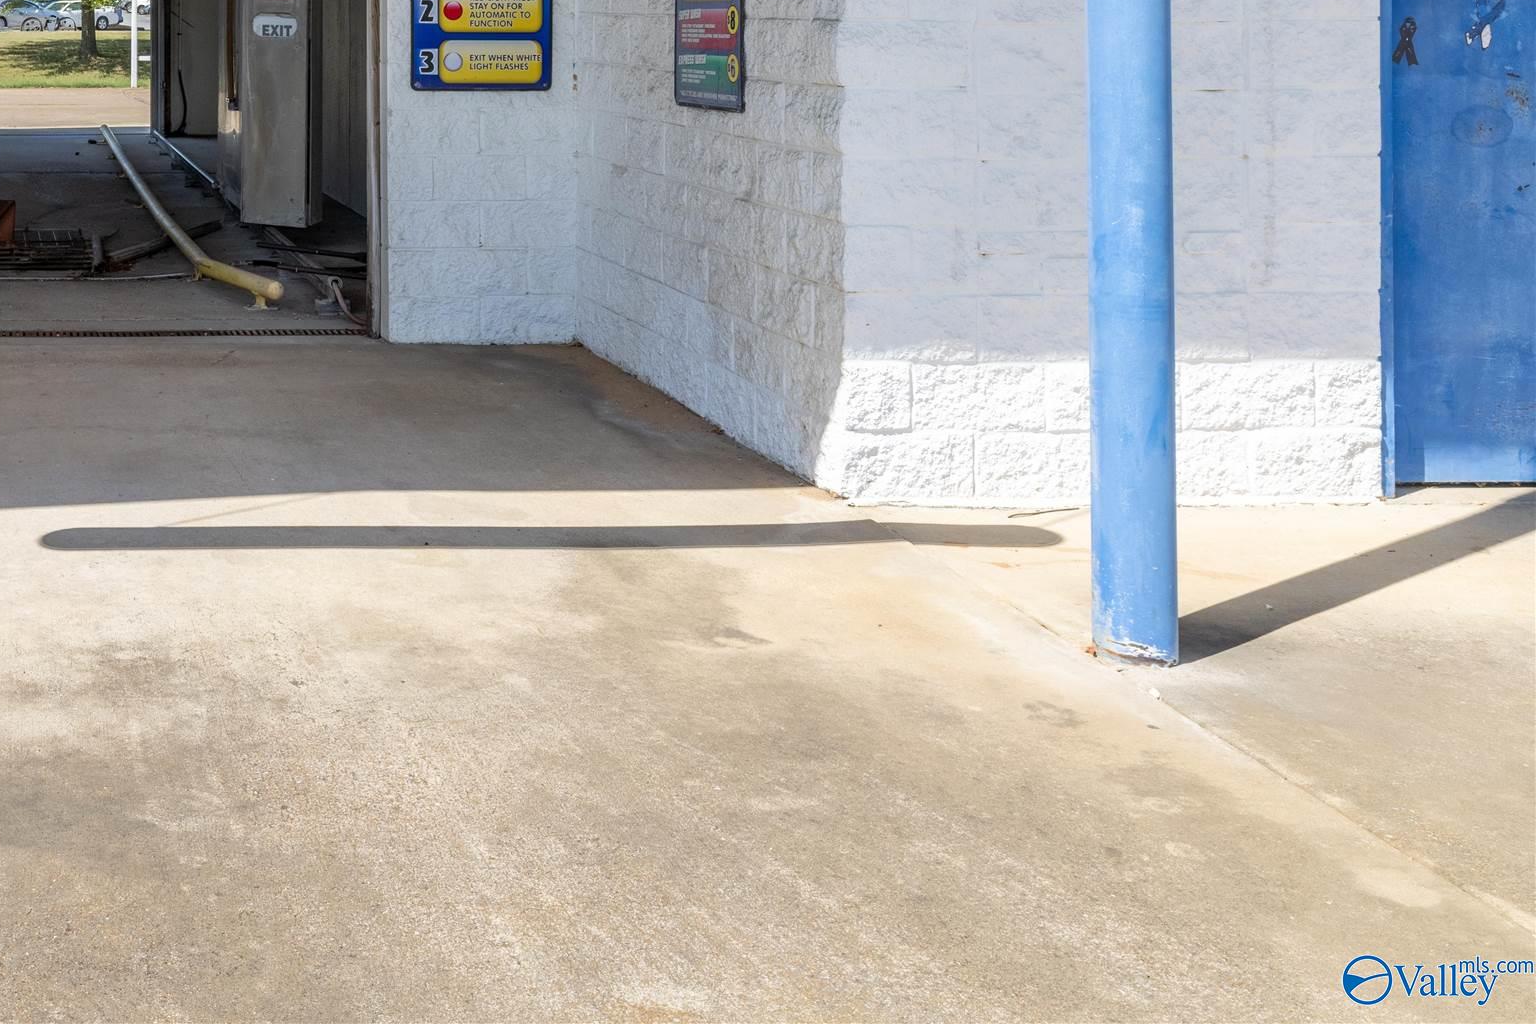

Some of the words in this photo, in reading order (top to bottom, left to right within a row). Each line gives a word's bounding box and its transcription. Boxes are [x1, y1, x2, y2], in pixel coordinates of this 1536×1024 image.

[420, 0, 434, 22] 2
[262, 24, 292, 37] EXIT
[420, 52, 434, 73] 3
